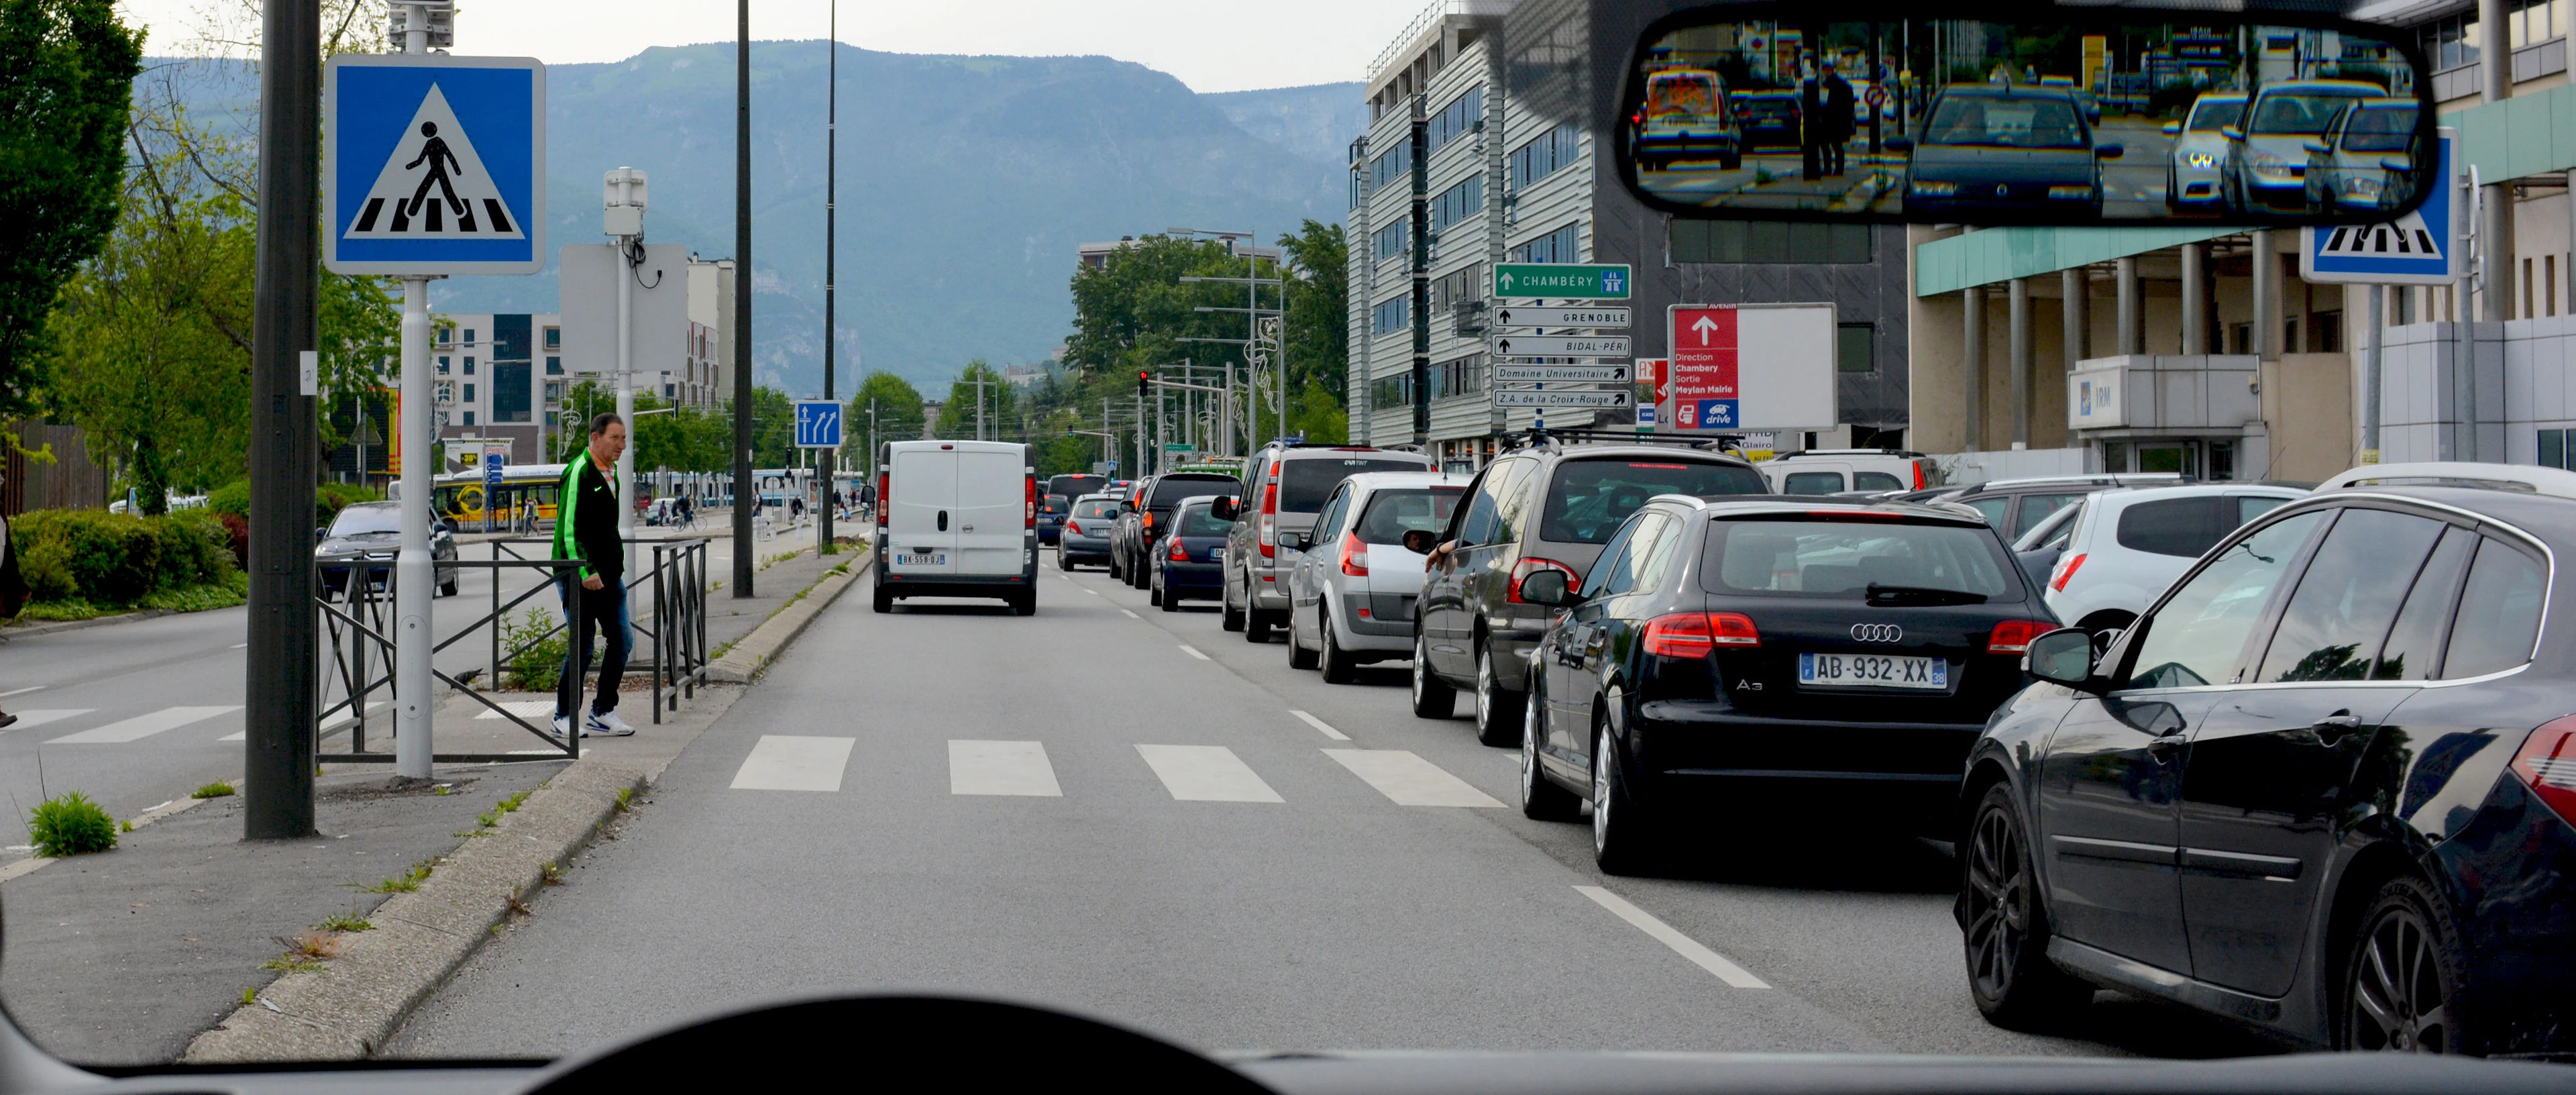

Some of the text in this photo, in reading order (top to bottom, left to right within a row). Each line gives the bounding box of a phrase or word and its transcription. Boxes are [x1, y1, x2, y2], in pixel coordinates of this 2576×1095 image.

[1523, 274, 1593, 286] CHAMBÉRY
[1563, 313, 1626, 322] GRENOBLE
[1566, 340, 1627, 351] BIDAL-PÉRI
[1499, 369, 1609, 378] Domaine Universitaire
[1675, 364, 1719, 373] Chambery
[1675, 375, 1701, 383] Sortie
[1675, 386, 1733, 395] Meylan Mairie
[1499, 395, 1609, 406] Z.A. de la Croix-Rouge
[2096, 386, 2110, 408] IRM
[1706, 415, 1731, 424] drive
[1817, 656, 1928, 682] AB-932-XX
[1933, 672, 1944, 683] 38
[1736, 679, 1763, 690] A3
